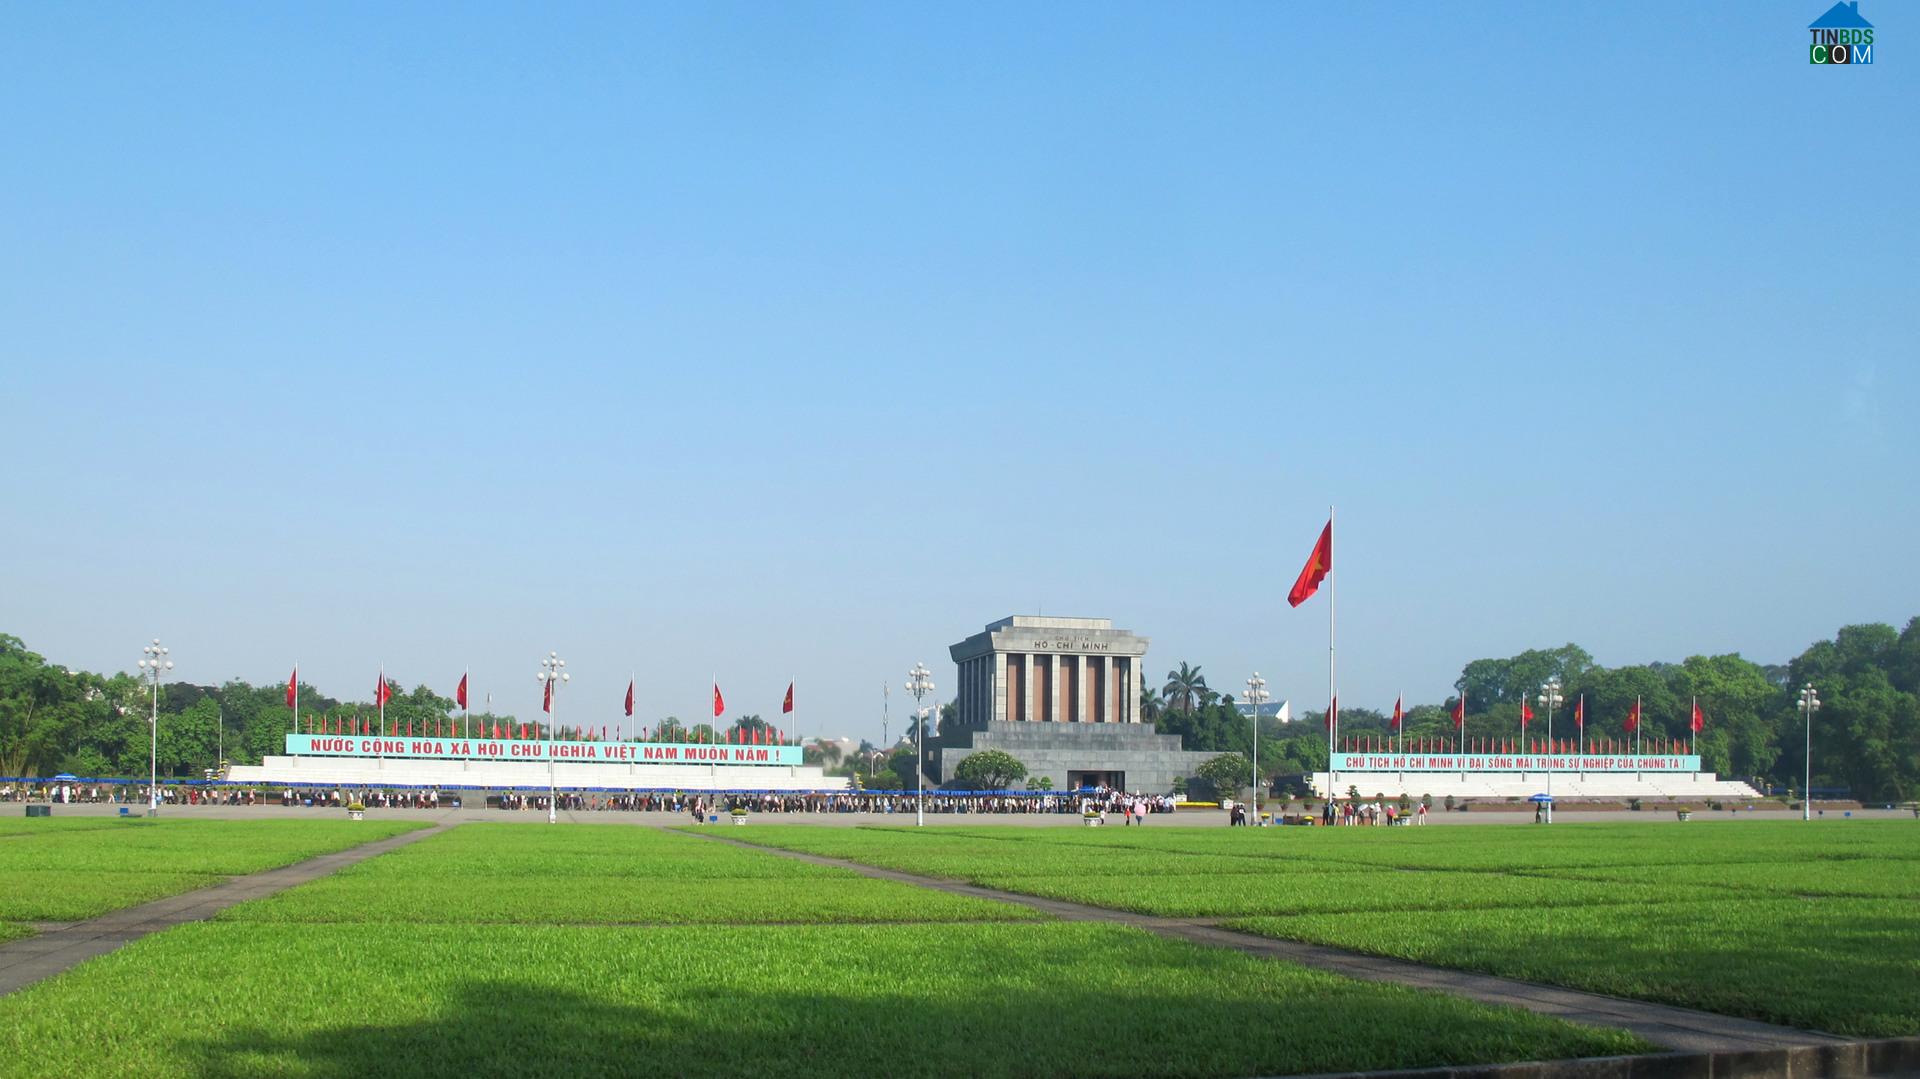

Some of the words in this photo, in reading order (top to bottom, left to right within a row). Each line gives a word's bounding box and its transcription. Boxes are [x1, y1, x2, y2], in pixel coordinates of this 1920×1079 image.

[361, 738, 405, 756] CỘNG
[411, 739, 443, 754] HÒA
[451, 740, 470, 755] XÃ
[478, 742, 504, 758] HỘI
[511, 742, 542, 757] CHỦ
[604, 744, 636, 760] VIỆT
[644, 747, 678, 760] NAM
[685, 746, 728, 761] MUÔN
[1428, 757, 1453, 768] MINH
[1537, 758, 1565, 769] TRONG
